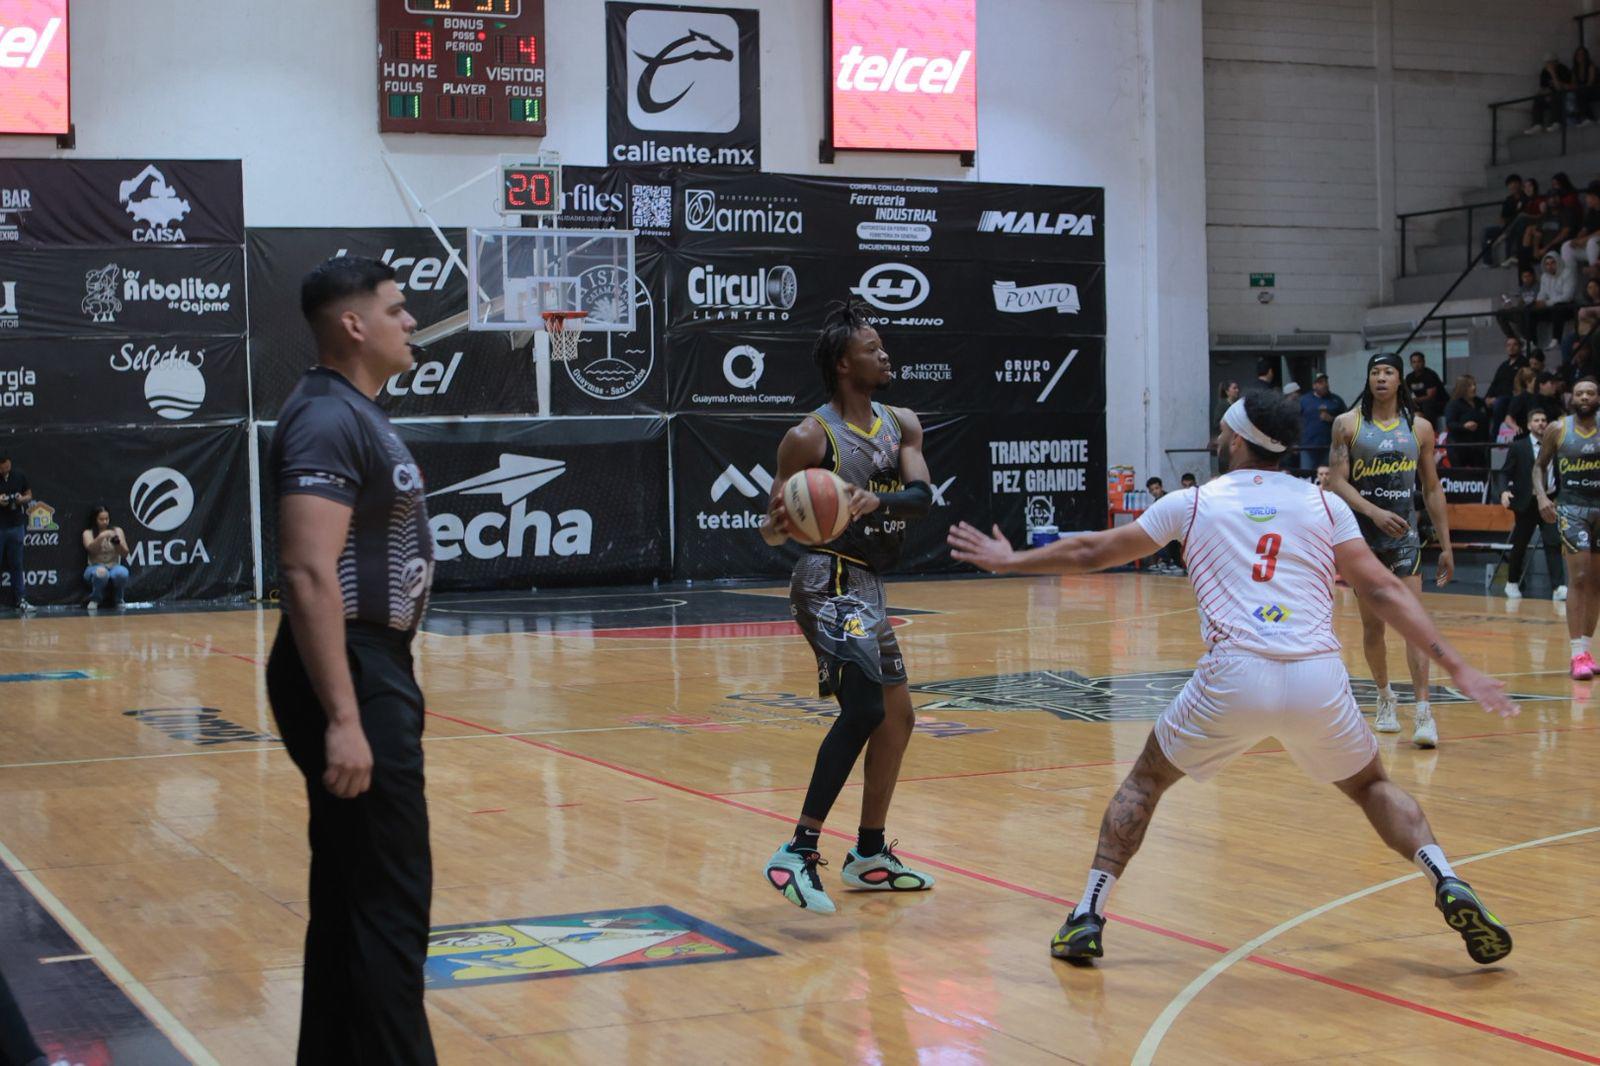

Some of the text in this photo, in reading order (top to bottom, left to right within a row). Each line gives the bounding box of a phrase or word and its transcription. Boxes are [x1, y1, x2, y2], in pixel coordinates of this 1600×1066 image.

[443, 18, 484, 30] BONUS
[0, 17, 62, 68] el
[453, 31, 475, 40] POSS
[415, 32, 432, 60] 8
[445, 42, 483, 52] PERIOD
[519, 36, 536, 64] 4
[383, 62, 438, 78] HOME
[466, 57, 471, 77] 1
[486, 67, 545, 83] VISITOR
[836, 45, 972, 94] telcel
[384, 81, 424, 93] FOULS
[443, 83, 486, 95] PLAYER
[505, 86, 543, 97] FOULS
[414, 95, 419, 118] 1
[613, 140, 755, 165] caliente.mx
[509, 173, 550, 205] 20
[2, 189, 31, 208] BAR
[716, 203, 803, 234] armiza
[875, 207, 938, 222] INDUSTRIAL
[977, 210, 1093, 236] MALPA
[132, 228, 186, 242] CAISA
[858, 243, 900, 251] ENCUENTRAS
[122, 268, 140, 279] Los
[1005, 287, 1070, 308] PONTO
[168, 300, 230, 315] de Cajeme
[693, 311, 790, 321] LLANTERO
[915, 363, 952, 371] HOTEL
[1005, 360, 1051, 371] GRUPO
[377, 352, 463, 396] cel
[995, 371, 1041, 382] VEJAR
[691, 393, 796, 405] Guaymas Protein Company
[989, 439, 1089, 465] TRANSPORTE
[992, 468, 1087, 493] PEZ GRANDE
[1441, 476, 1485, 494] Chevron
[1374, 487, 1411, 500] Coppel
[126, 538, 210, 566] MEGA
[1251, 532, 1283, 583] 3
